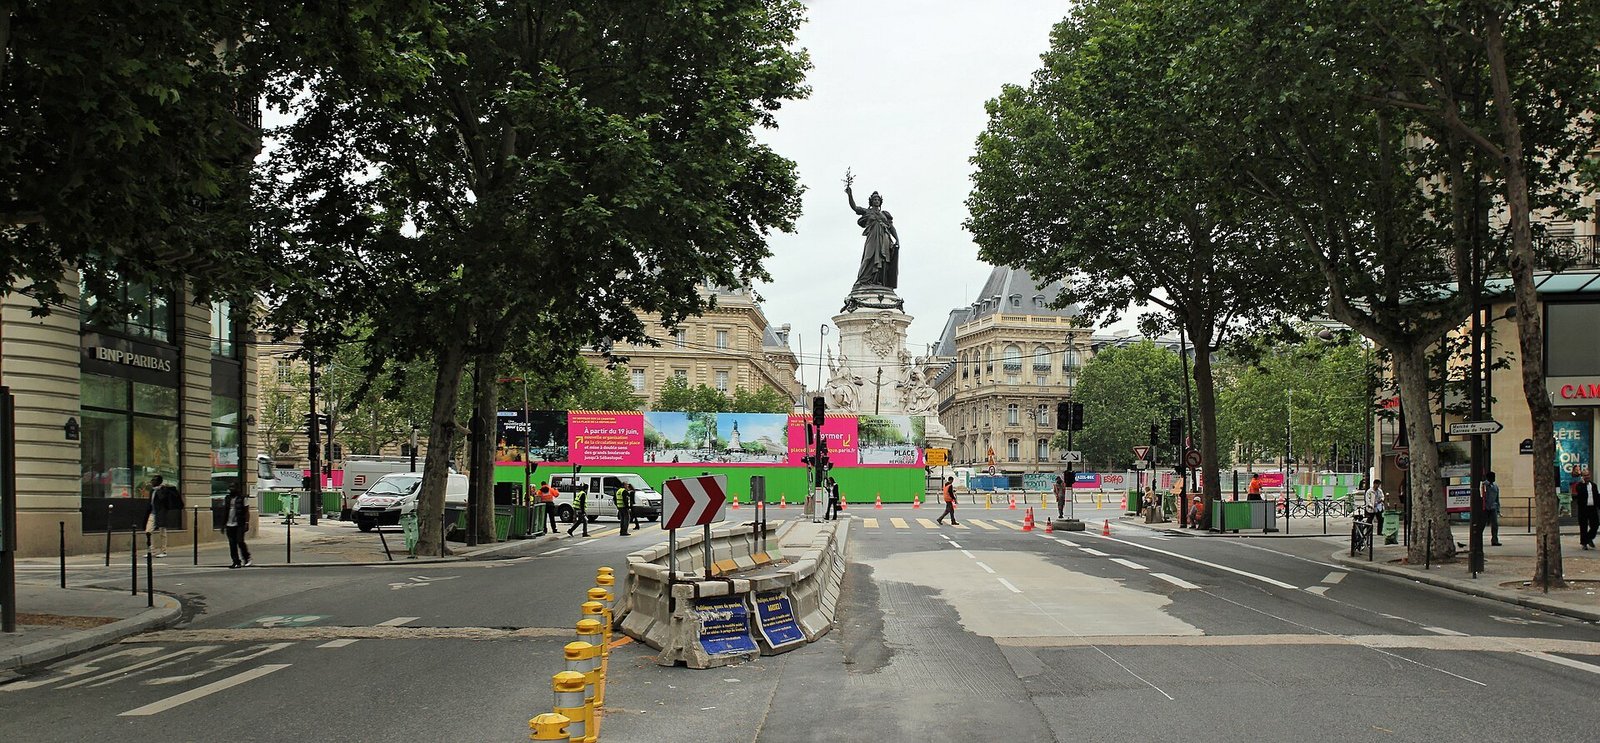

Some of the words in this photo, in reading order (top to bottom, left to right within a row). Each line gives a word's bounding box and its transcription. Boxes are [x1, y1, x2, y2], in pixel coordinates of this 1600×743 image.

[98, 347, 124, 362] BNP
[126, 353, 171, 372] PARIBAS
[584, 426, 590, 434] À
[590, 428, 608, 437] partir
[894, 449, 915, 457] PLACE
